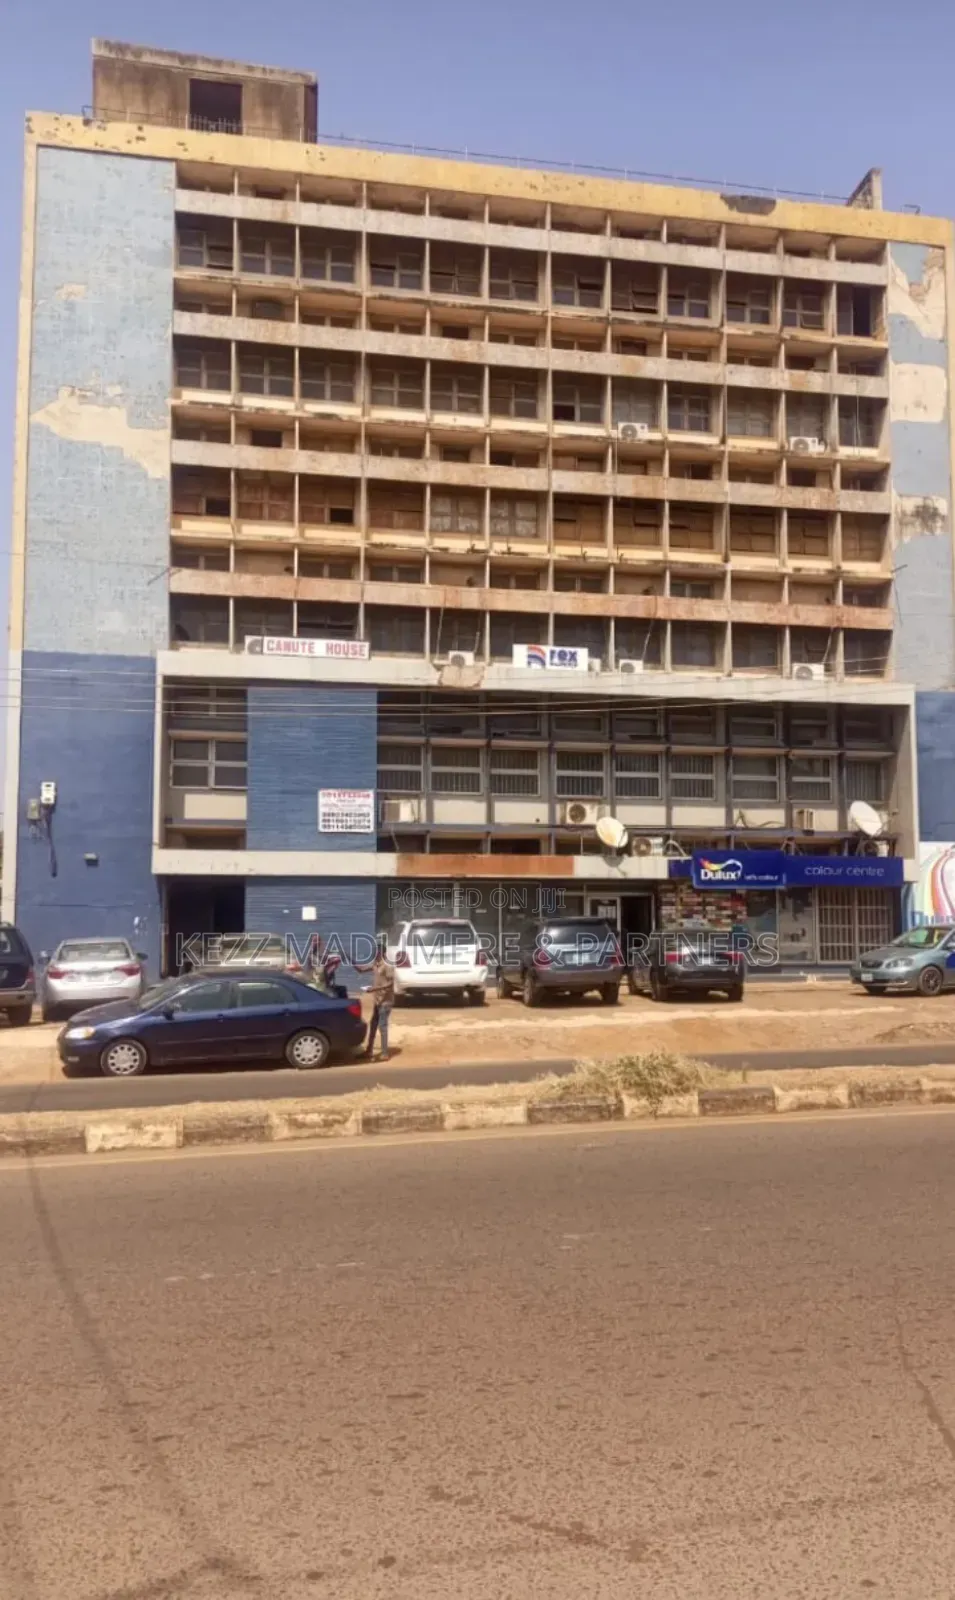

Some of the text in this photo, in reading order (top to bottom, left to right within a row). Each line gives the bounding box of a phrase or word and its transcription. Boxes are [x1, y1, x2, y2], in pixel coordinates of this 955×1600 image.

[266, 640, 367, 657] CANUTE HOUSE
[701, 868, 736, 880] Dulux
[804, 865, 885, 877] colour centre
